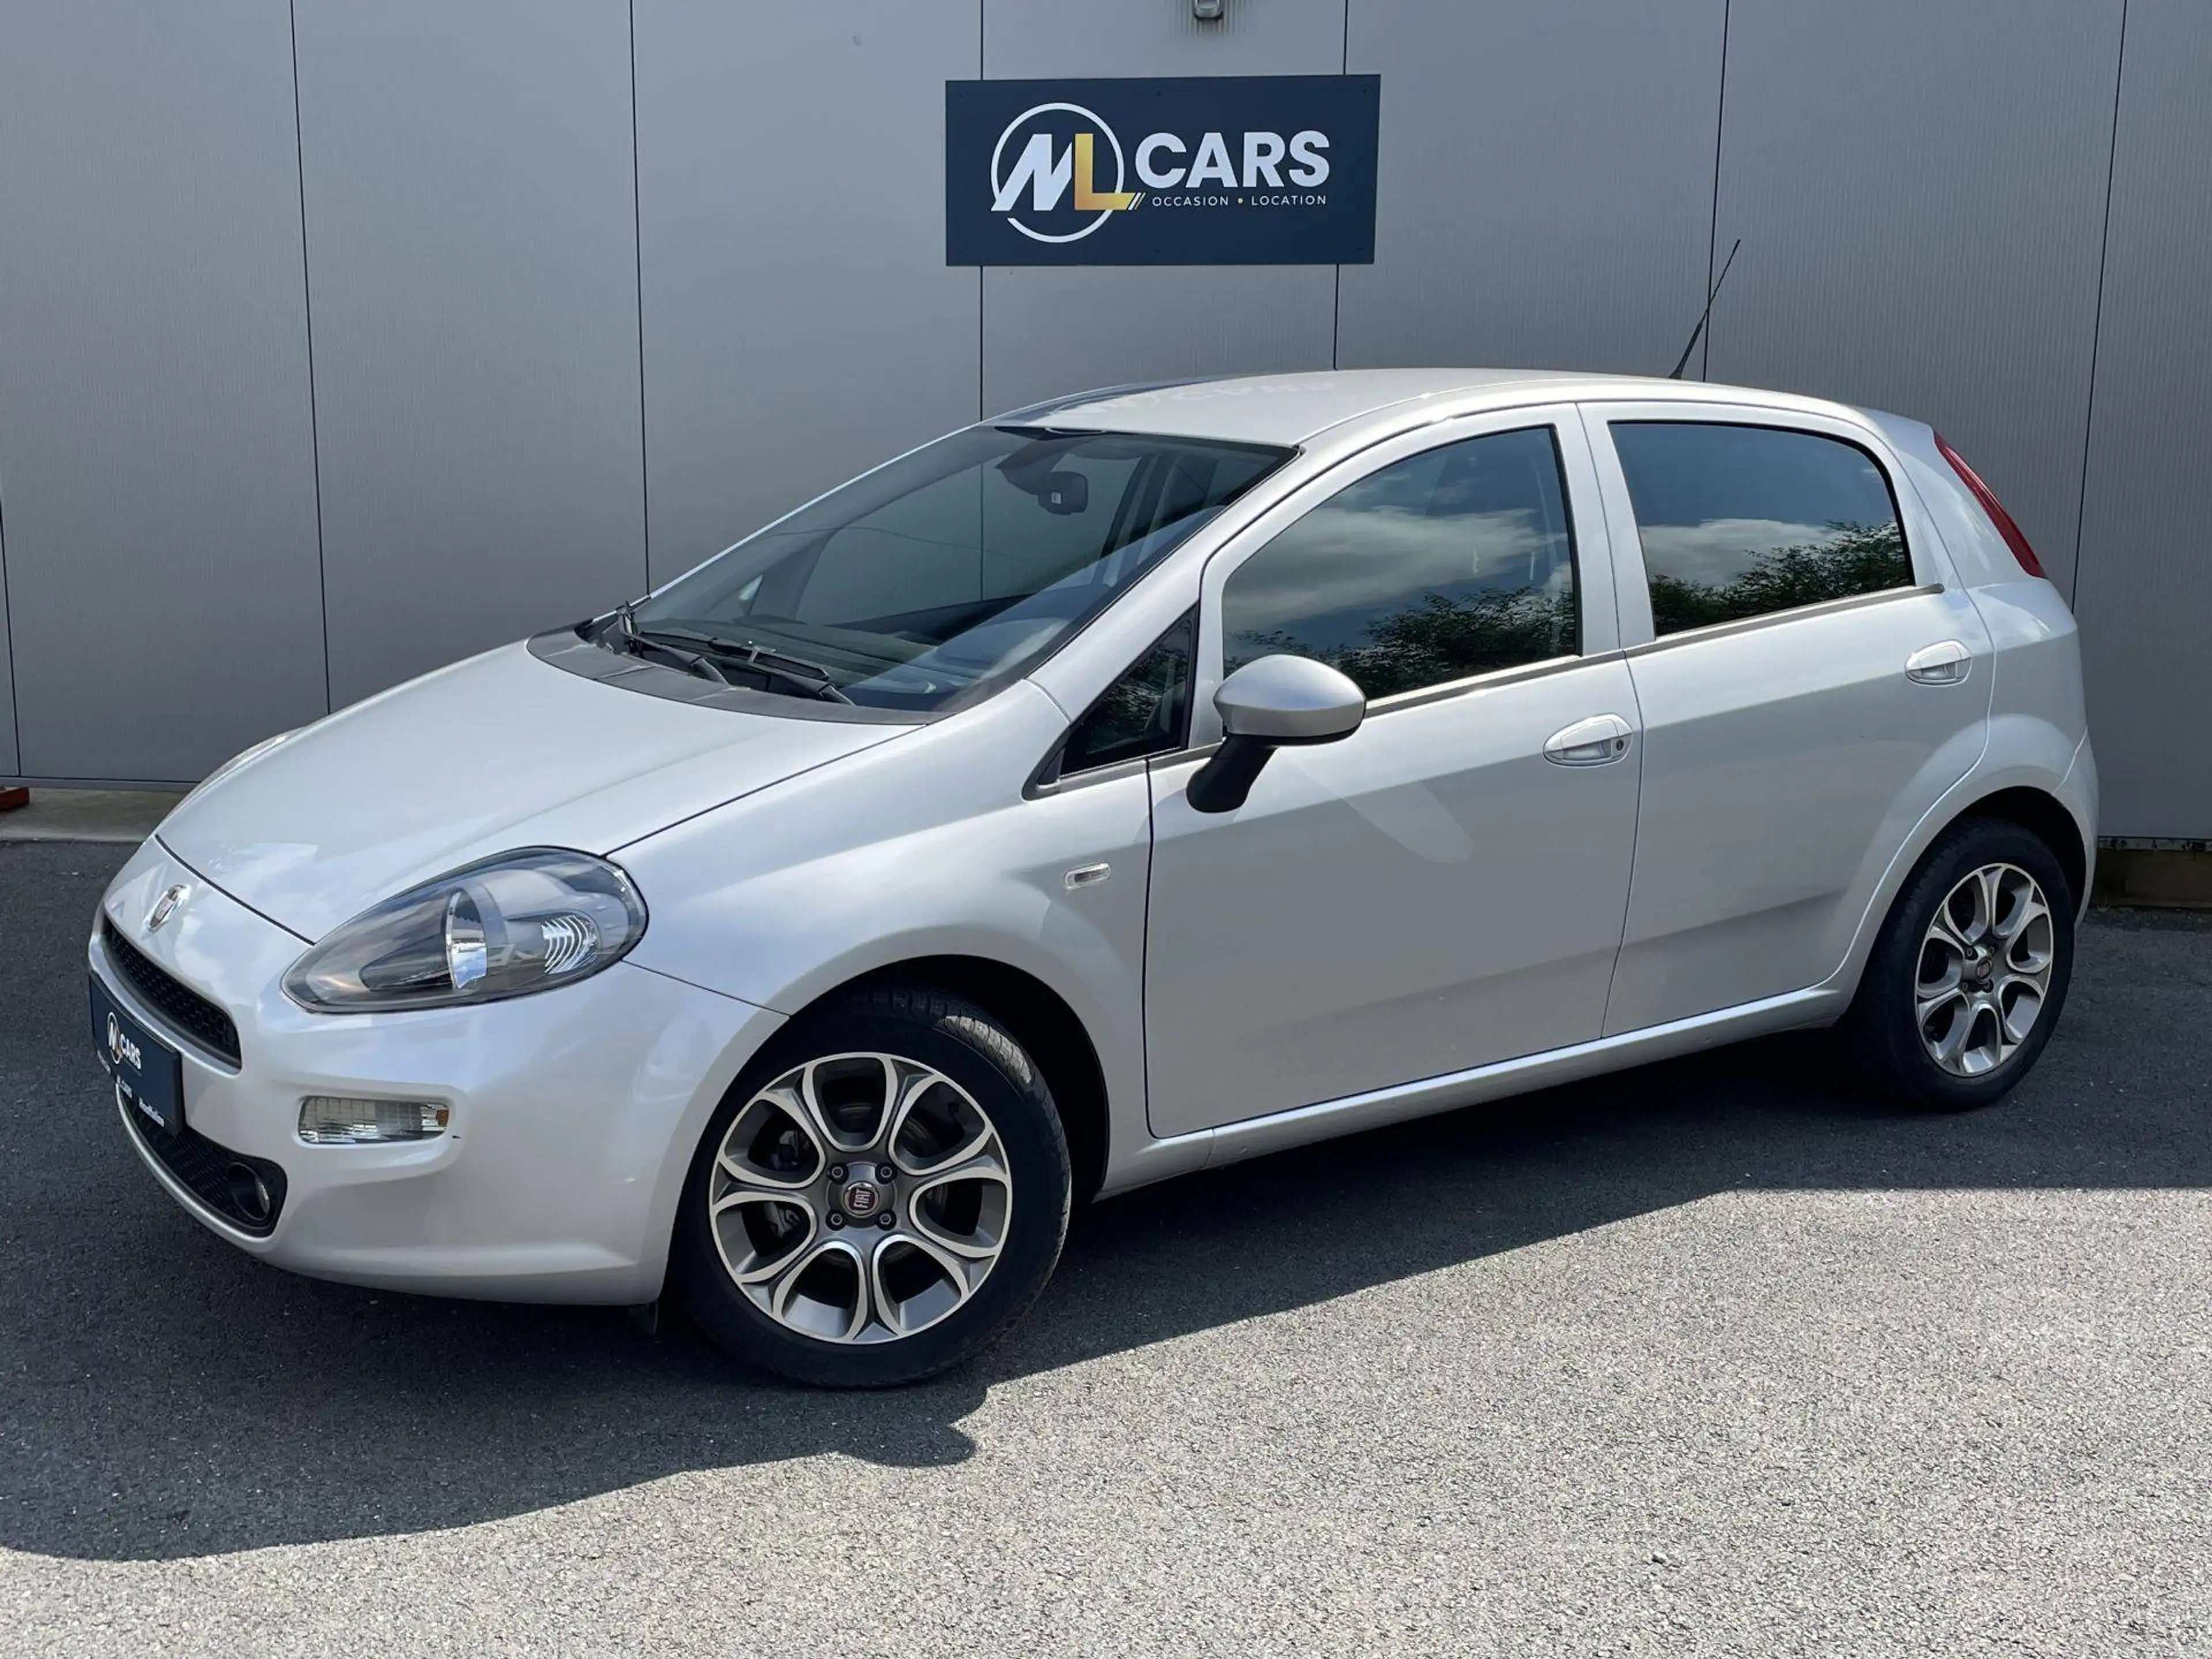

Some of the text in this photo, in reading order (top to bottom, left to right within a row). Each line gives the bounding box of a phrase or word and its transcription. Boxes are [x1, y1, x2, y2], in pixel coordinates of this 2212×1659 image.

[991, 131, 1330, 211] ML CARS
[1152, 195, 1327, 207] OCCASION LOCATION
[120, 1033, 141, 1070] CARS
[854, 1189, 871, 1209] FIAT
